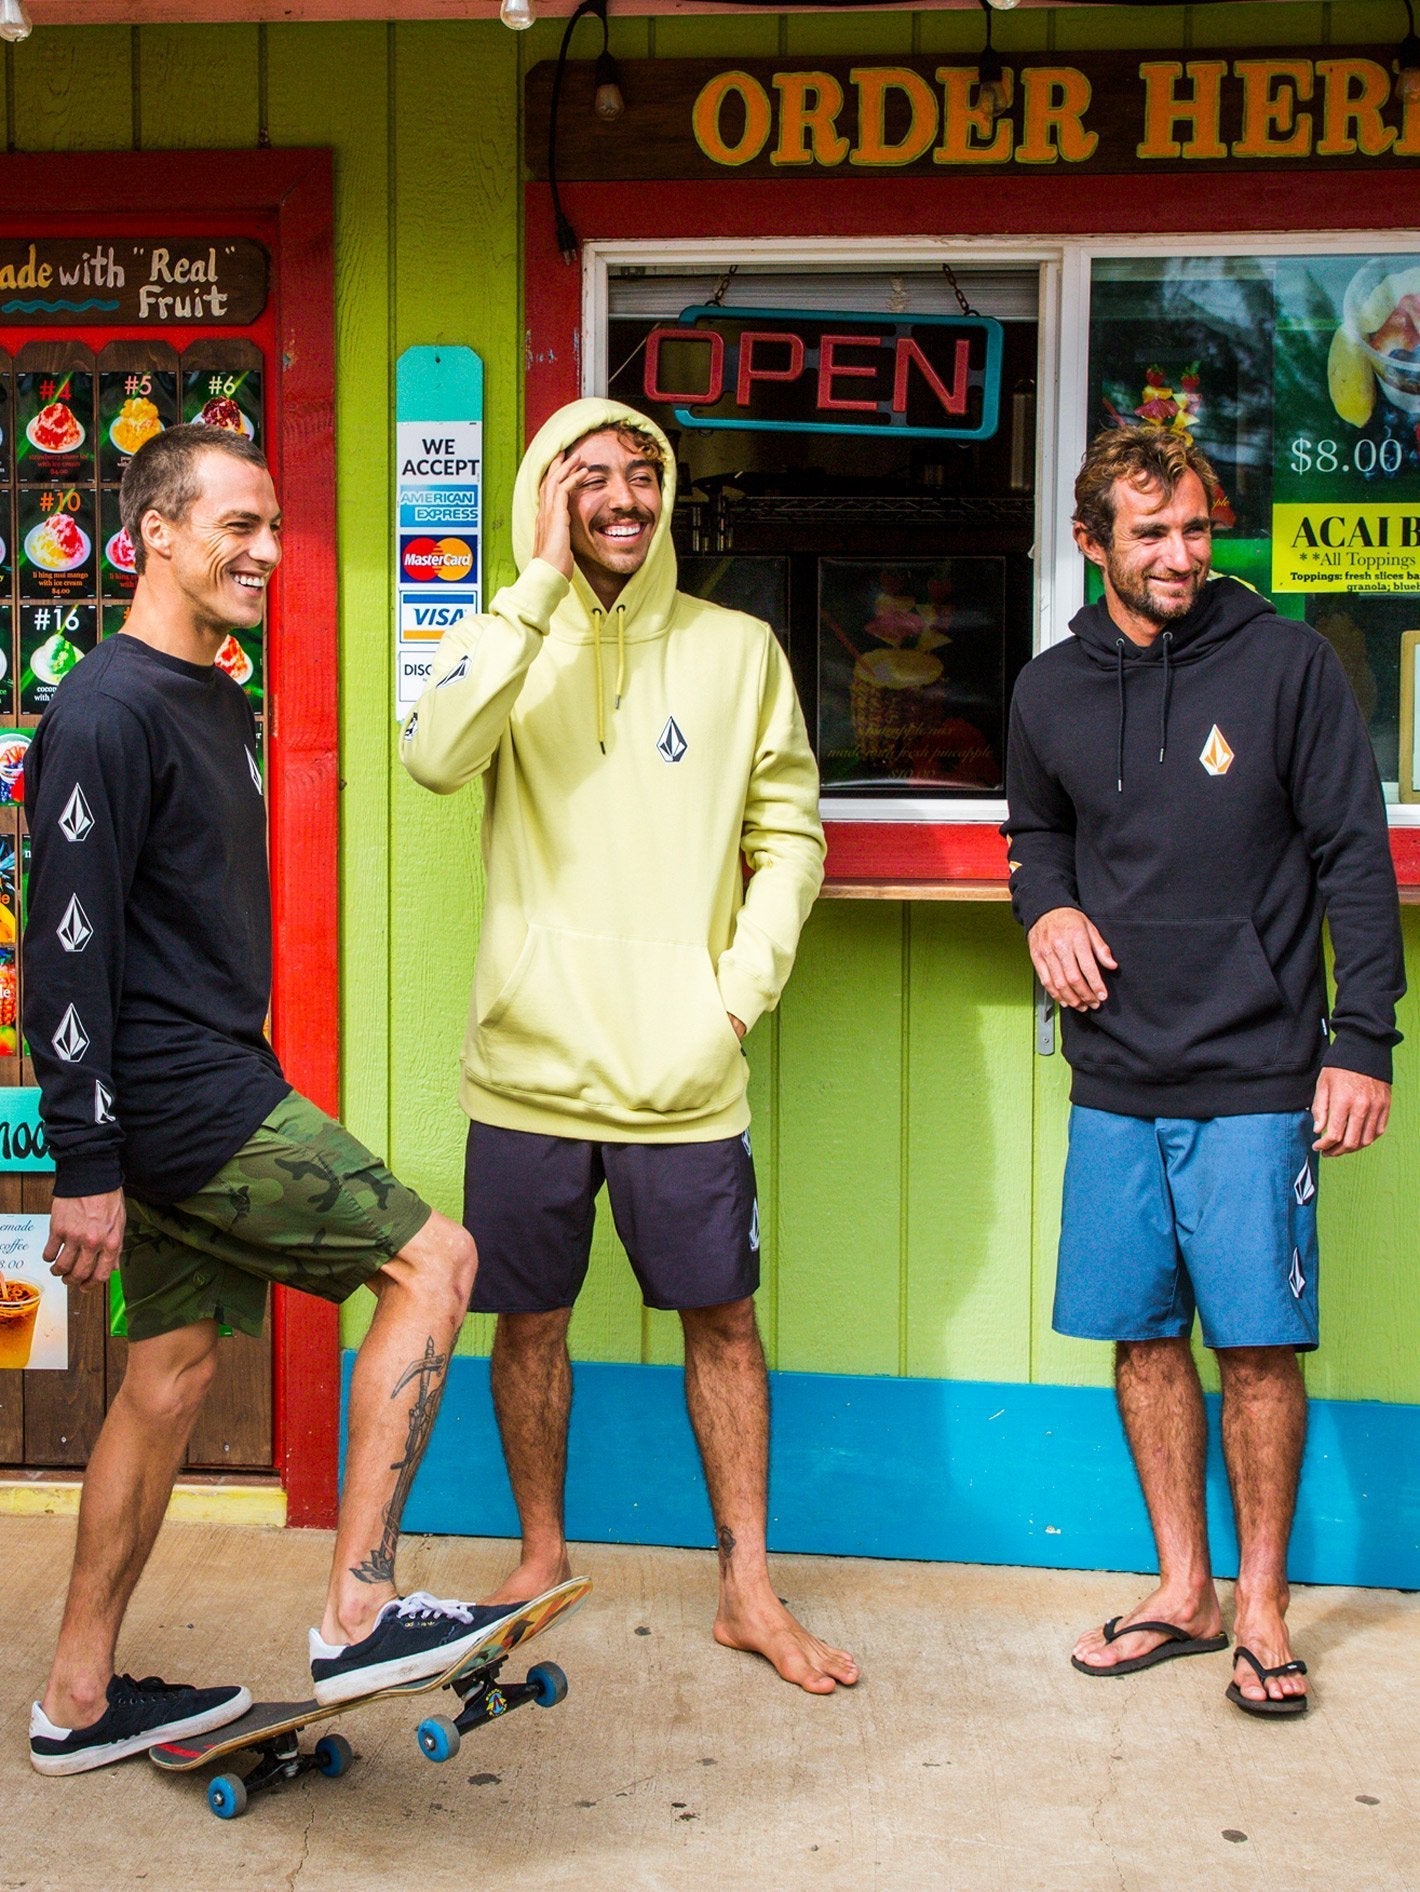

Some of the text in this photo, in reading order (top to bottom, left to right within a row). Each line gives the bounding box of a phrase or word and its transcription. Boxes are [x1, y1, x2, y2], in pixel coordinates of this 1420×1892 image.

[692, 66, 1099, 165] ORDER
[59, 245, 126, 289] with
[138, 284, 229, 320] Fruit
[644, 328, 969, 415] OPEN
[40, 379, 73, 401] #4
[123, 375, 153, 396] #5
[208, 375, 237, 396] #6
[421, 438, 456, 455] WE
[1290, 437, 1403, 476] $8.00
[401, 459, 480, 476] ACCEPT
[39, 491, 82, 512] #10
[400, 491, 474, 505] AMERICAN
[416, 507, 479, 520] EXPRESS
[1290, 515, 1391, 549] ACAI
[403, 553, 472, 567] MasterCard
[1346, 551, 1416, 571] Toppings
[38, 579, 53, 587] with
[1290, 571, 1343, 583] Toppings:
[1345, 571, 1372, 581] fresh
[1374, 571, 1405, 581] slices
[1346, 581, 1391, 593] granola;
[34, 607, 80, 631] #16
[413, 608, 466, 626] VISA
